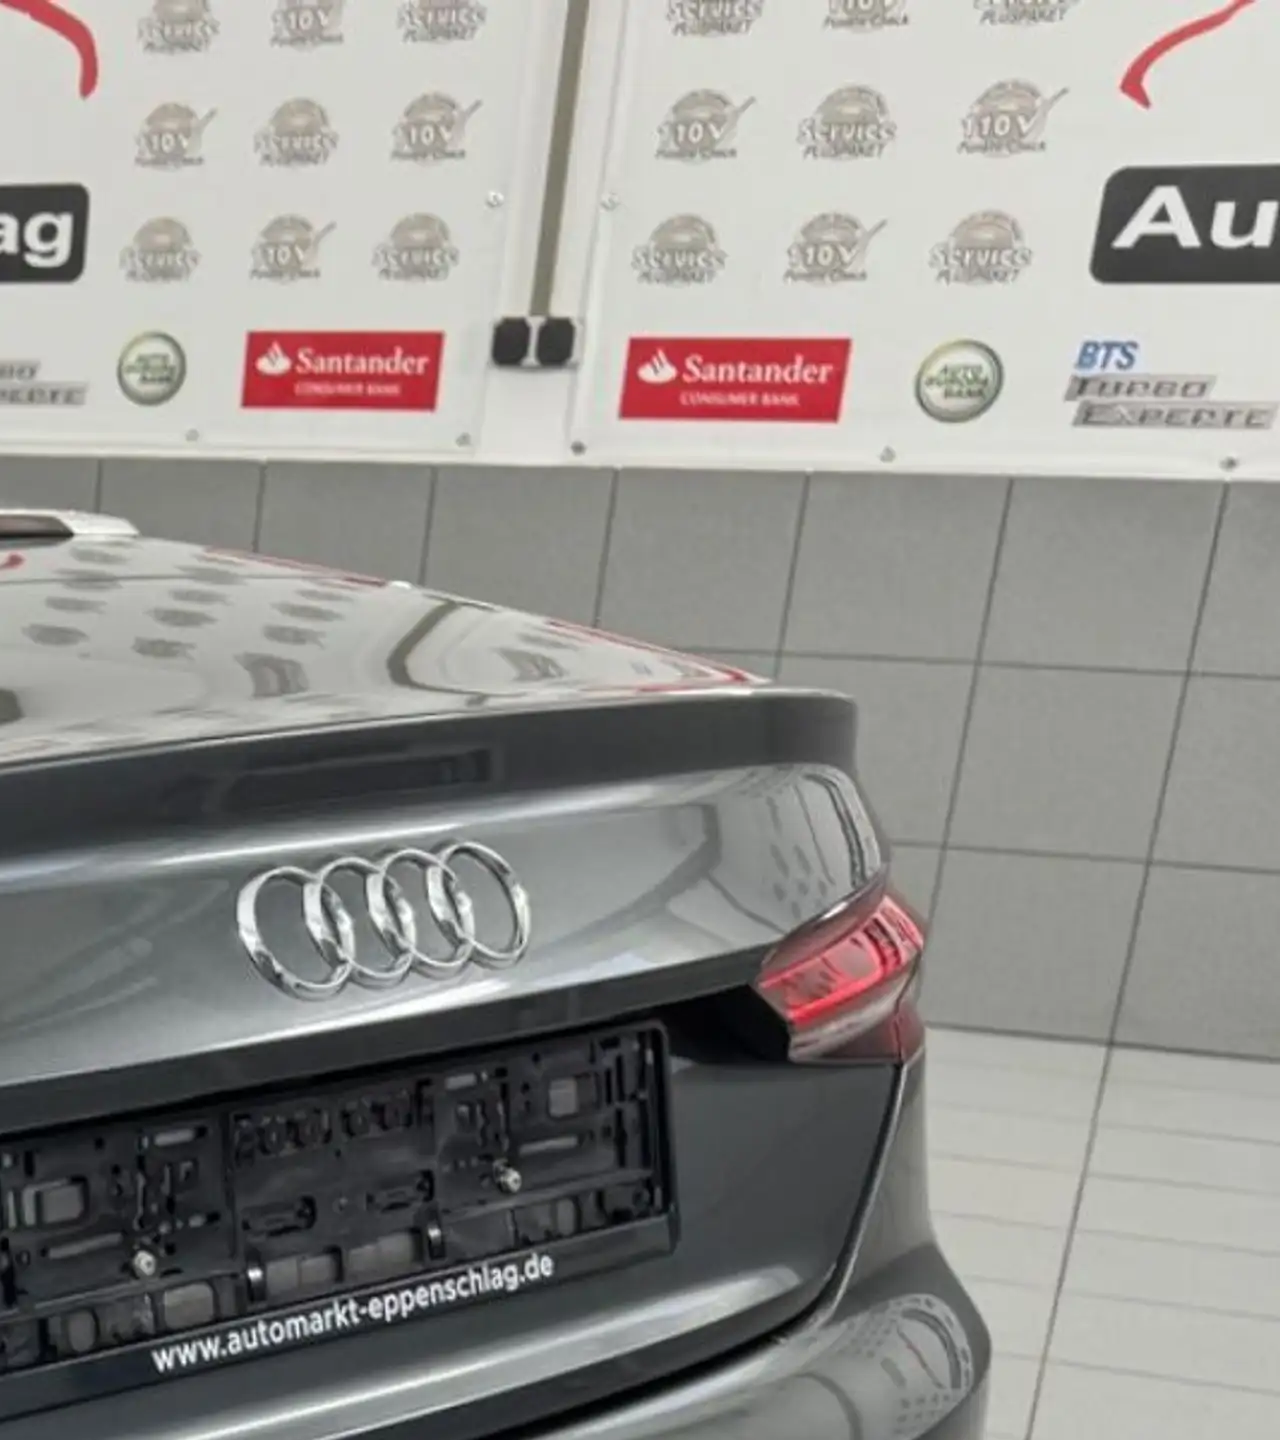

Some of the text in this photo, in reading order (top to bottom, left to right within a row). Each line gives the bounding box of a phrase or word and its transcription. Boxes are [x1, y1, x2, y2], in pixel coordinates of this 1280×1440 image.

[1110, 184, 1280, 249] Au
[294, 345, 430, 376] Santander
[681, 352, 834, 385] Santander
[1074, 340, 1139, 371] BTS
[151, 1252, 555, 1374] www.automarkt-eppenschlag.de
